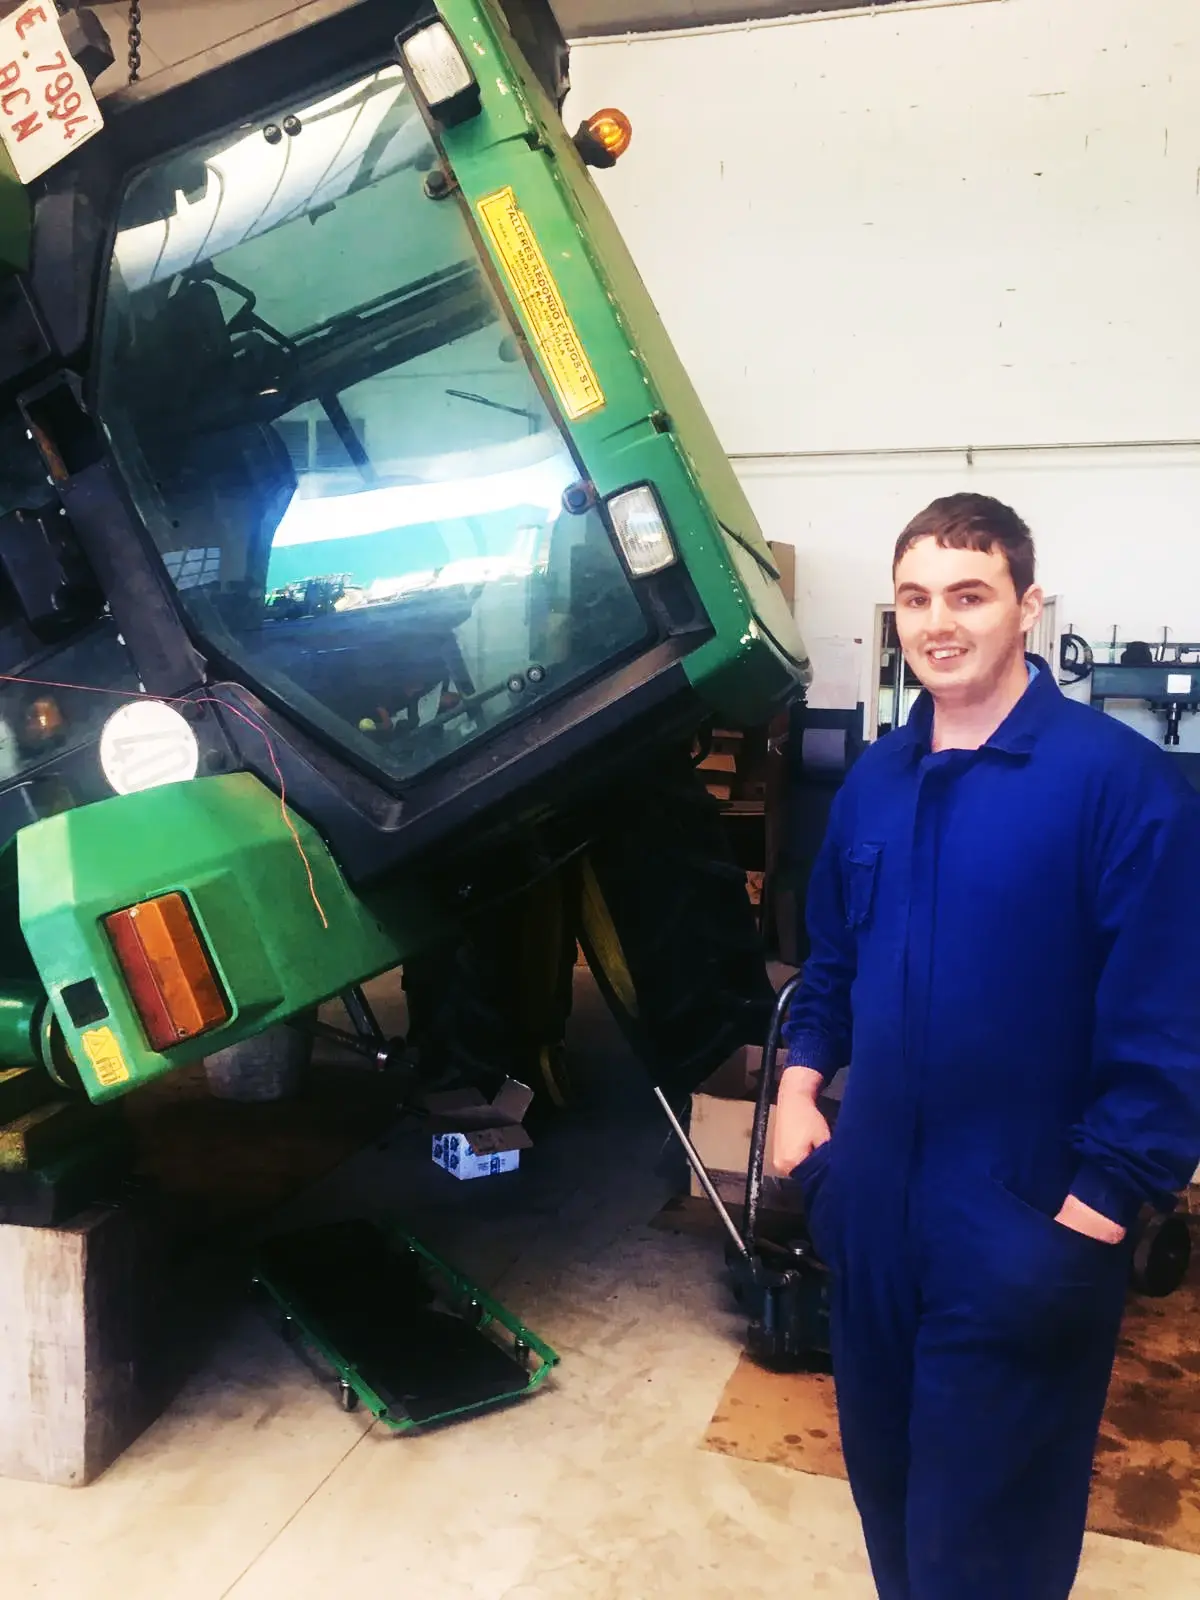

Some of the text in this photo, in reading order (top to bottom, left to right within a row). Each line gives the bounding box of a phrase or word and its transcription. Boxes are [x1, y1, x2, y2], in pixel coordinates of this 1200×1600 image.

[35, 50, 89, 140] 7994
[506, 204, 535, 261] TALLERES
[532, 263, 560, 320] REDONDO
[111, 729, 191, 792] 40
